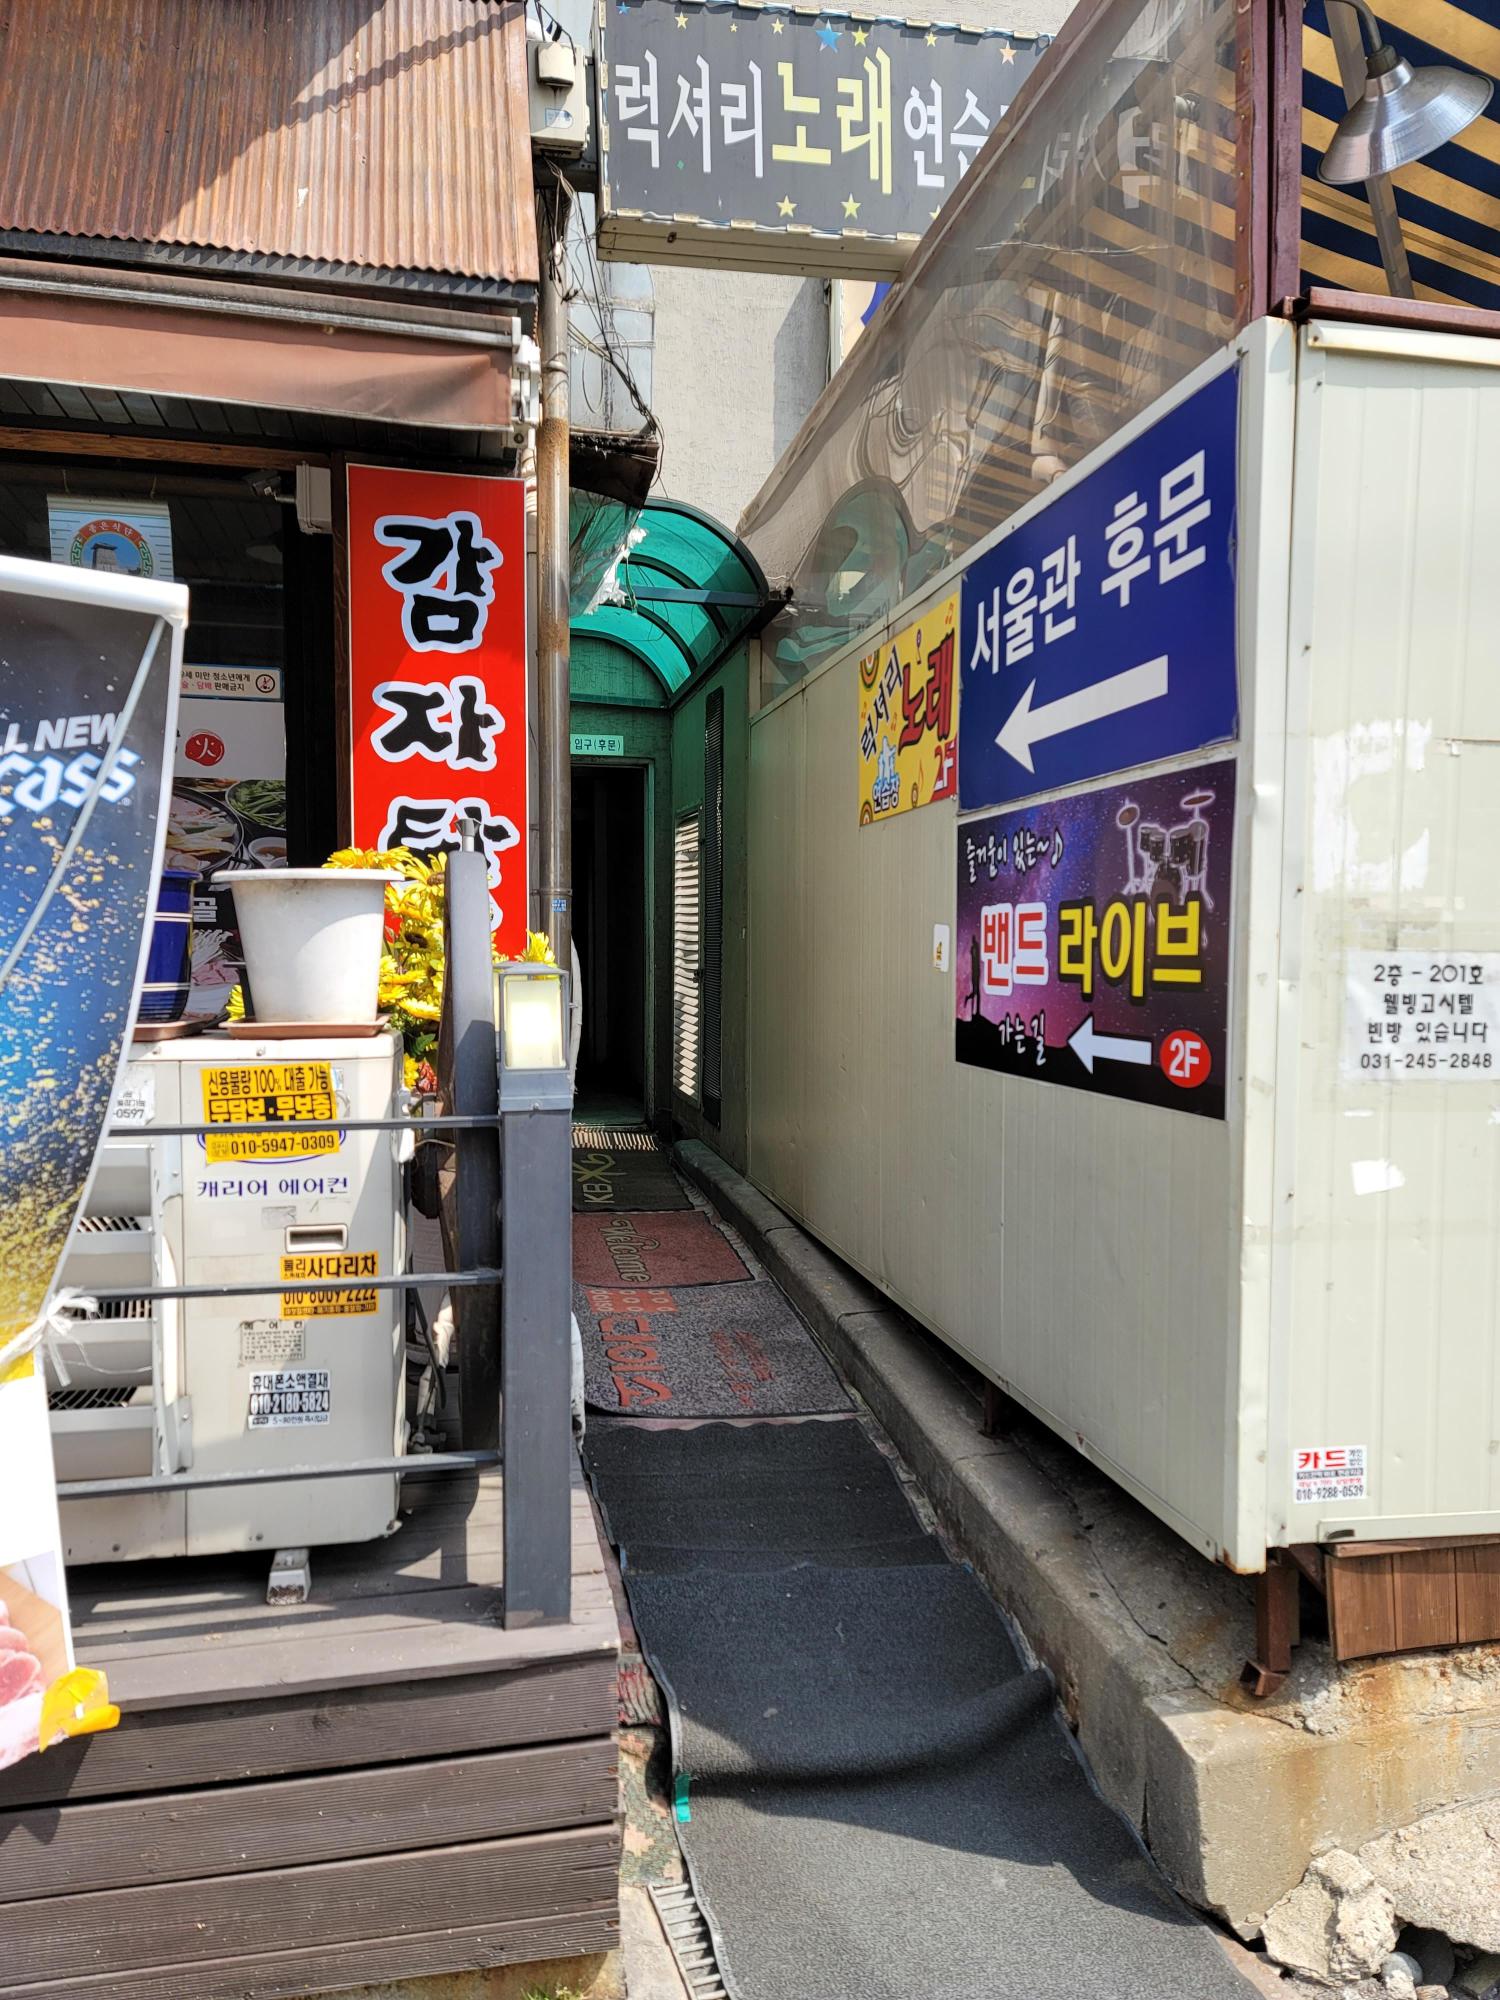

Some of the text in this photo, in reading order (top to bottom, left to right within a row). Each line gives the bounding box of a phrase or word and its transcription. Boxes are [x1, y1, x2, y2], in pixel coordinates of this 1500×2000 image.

[614, 48, 764, 179] 럭셔리
[771, 46, 893, 195] 노래
[970, 449, 1211, 674] 서울관 후문
[860, 644, 903, 762] 럭셔리
[898, 628, 956, 756] 노래
[34, 712, 122, 751] NEW
[574, 738, 621, 752] 입구(후문)
[872, 776, 900, 813] 연습장
[982, 901, 1201, 998] 밴드 라이브
[999, 1010, 1046, 1066] 가는 길
[1368, 1022, 1488, 1044] 빈방 있습니다
[1169, 1037, 1201, 1078] 2F
[1361, 1053, 1492, 1069] 031-245-2848
[209, 1070, 251, 1096] 신용불량
[284, 1066, 305, 1091] 대출
[309, 1064, 328, 1090] 가능
[231, 1135, 335, 1156] 010-5947-0309
[197, 1177, 348, 1198] 캐리어 에어컨
[307, 1254, 376, 1278] 사다리차
[1298, 1449, 1346, 1469] 카드
